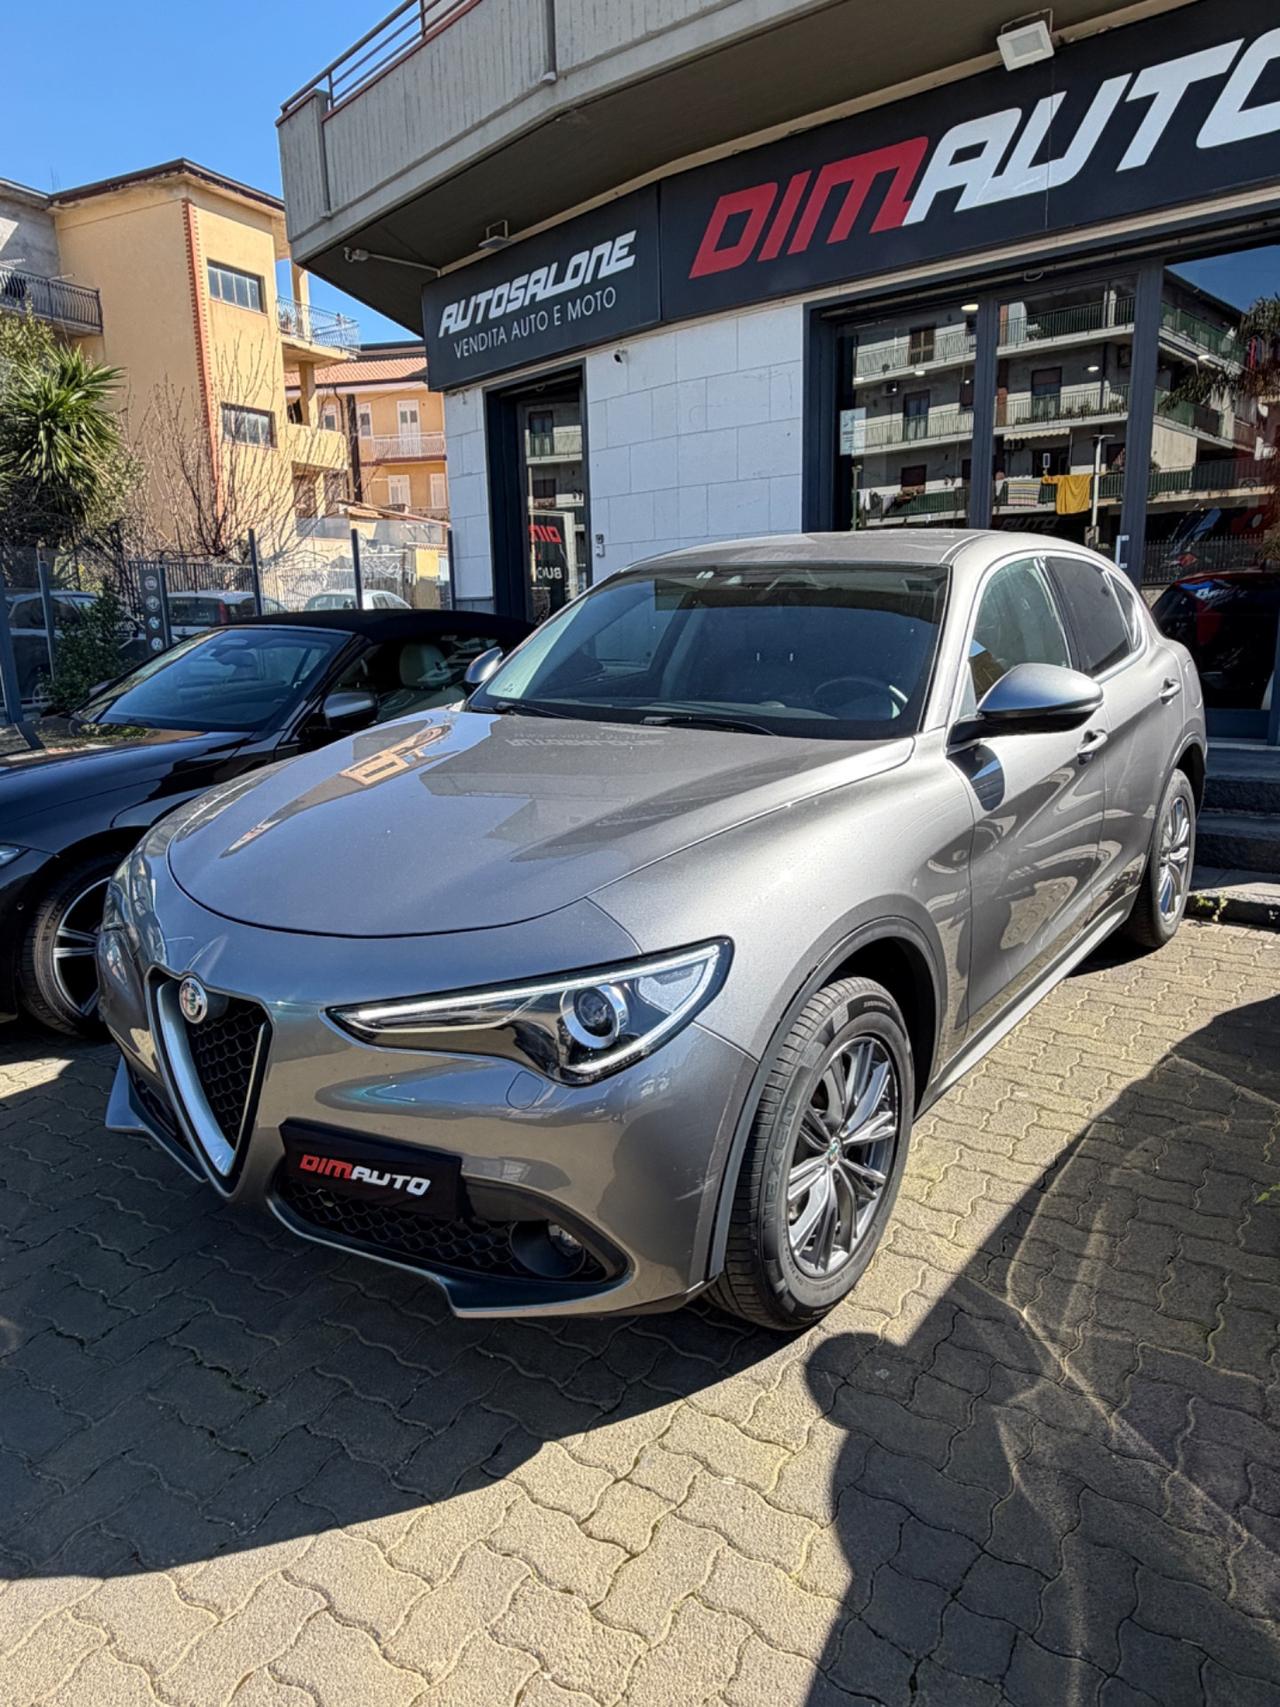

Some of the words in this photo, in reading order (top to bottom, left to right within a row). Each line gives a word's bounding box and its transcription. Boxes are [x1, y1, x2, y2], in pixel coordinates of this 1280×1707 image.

[438, 230, 637, 338] AUTOSALONE
[454, 325, 508, 358] VENDITA
[511, 311, 549, 340] AUTO
[553, 305, 561, 325] E
[567, 287, 616, 322] MOTO
[300, 1154, 431, 1196] DIMAUTO
[763, 1104, 796, 1226] NEXEN
